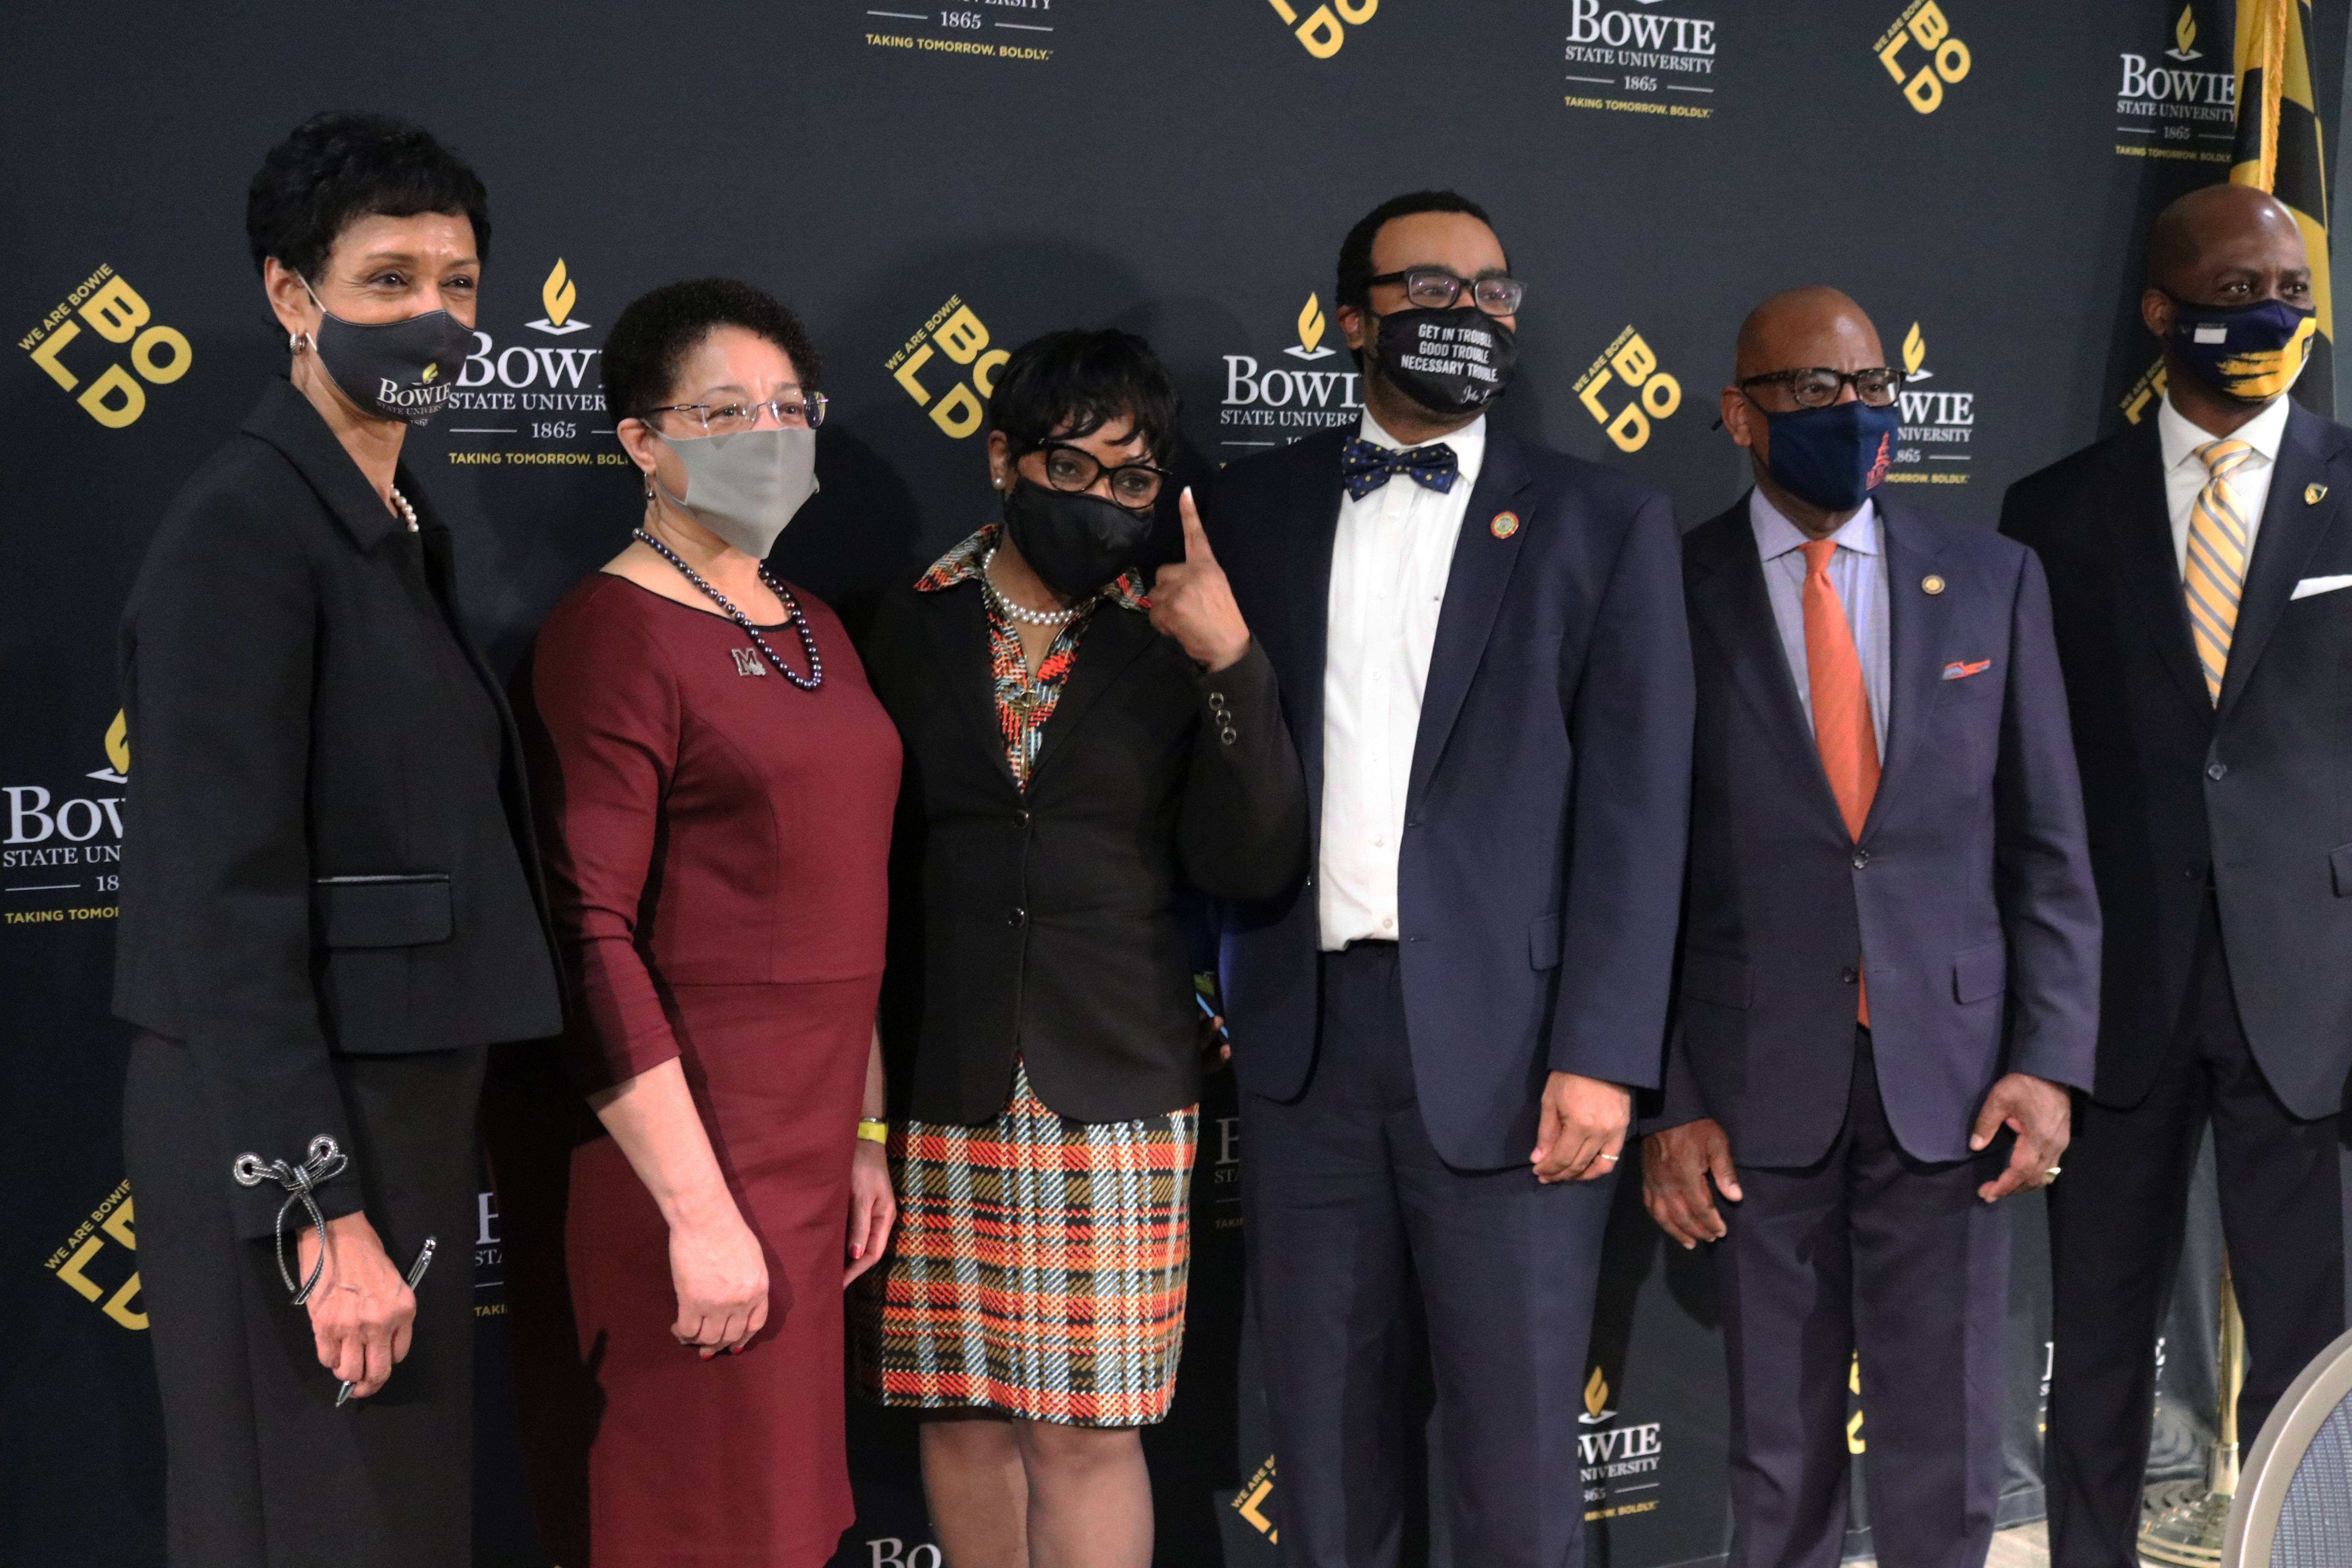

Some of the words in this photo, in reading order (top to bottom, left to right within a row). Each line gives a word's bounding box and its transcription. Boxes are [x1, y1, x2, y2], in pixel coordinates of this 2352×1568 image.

[941, 11, 981, 29] 1865
[1566, 0, 1716, 55] BOWIE
[866, 34, 914, 48] TAKING
[917, 38, 996, 56] TOMORROW.
[1565, 46, 1614, 64] STATE
[1618, 51, 1715, 73] UNIVERSITY
[1624, 76, 1657, 92] 1865
[2117, 100, 2156, 116] STATE
[18, 327, 45, 351] WE
[43, 302, 71, 331] ARE
[68, 263, 113, 307] BOWIE
[884, 350, 906, 370] WE
[905, 328, 927, 353] ARE
[925, 294, 962, 332] BOWIE
[1418, 323, 1440, 339] GET
[1442, 328, 1455, 341] IN
[1419, 341, 1449, 357] GOOD
[456, 332, 605, 388] BOW
[1401, 354, 1465, 376] NECESSARY
[376, 377, 451, 407] BOWIE
[448, 393, 515, 410] STATE
[1221, 409, 1274, 426] STATE
[532, 421, 577, 439] 1865
[449, 452, 502, 464] TAKING
[506, 453, 593, 465] TOMORROW.
[597, 454, 628, 465] BOL
[3, 847, 78, 867] STATE
[5, 909, 64, 924] TAKING
[44, 1247, 69, 1269] WE
[68, 1220, 95, 1249] ARE
